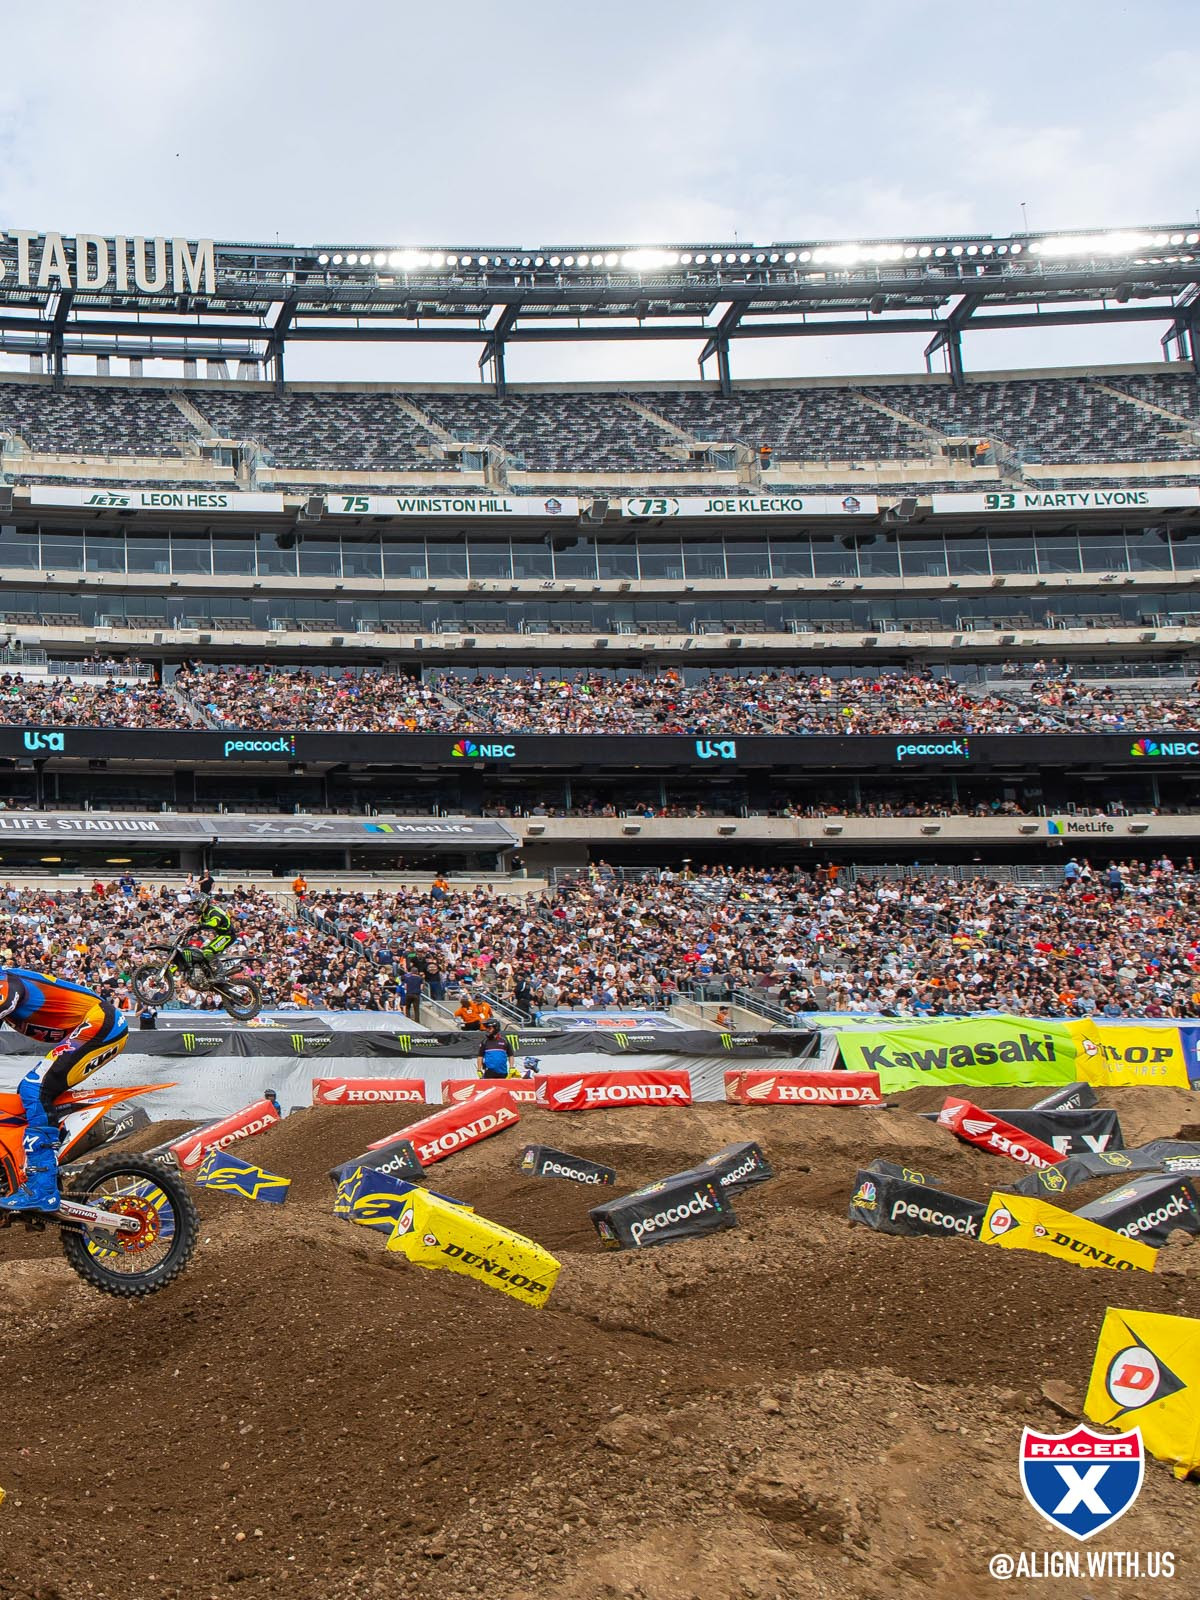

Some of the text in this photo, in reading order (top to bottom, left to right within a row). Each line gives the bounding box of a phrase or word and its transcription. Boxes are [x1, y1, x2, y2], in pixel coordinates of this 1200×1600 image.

[141, 492, 183, 507] LEON
[186, 493, 227, 508] HESS
[341, 497, 513, 512] 75 WINSTON HILL
[704, 499, 736, 512] JOE
[739, 498, 803, 512] KLECKO
[985, 491, 1149, 510] 93 MARTY LYONS
[224, 738, 289, 757] peacock
[480, 743, 515, 757] NBC
[897, 742, 963, 761] peacock
[1161, 742, 1198, 756] NBC
[56, 820, 160, 831] STADIUM
[396, 825, 473, 833] MetLife
[1067, 822, 1114, 832] MetLife
[860, 1033, 1056, 1071] Kawasaki
[84, 1046, 119, 1076] KTM
[347, 1090, 424, 1101] HONDA
[584, 1085, 689, 1101] HONDA
[777, 1085, 879, 1101] HONDA
[204, 1114, 277, 1152] HONDA
[418, 1107, 517, 1161] HONDA
[720, 1157, 756, 1187] eacock
[630, 1192, 714, 1246] peacock
[891, 1200, 978, 1236] peacock
[992, 1215, 1009, 1228] D
[441, 1243, 548, 1294] DUNLOP
[1112, 1364, 1155, 1391] D
